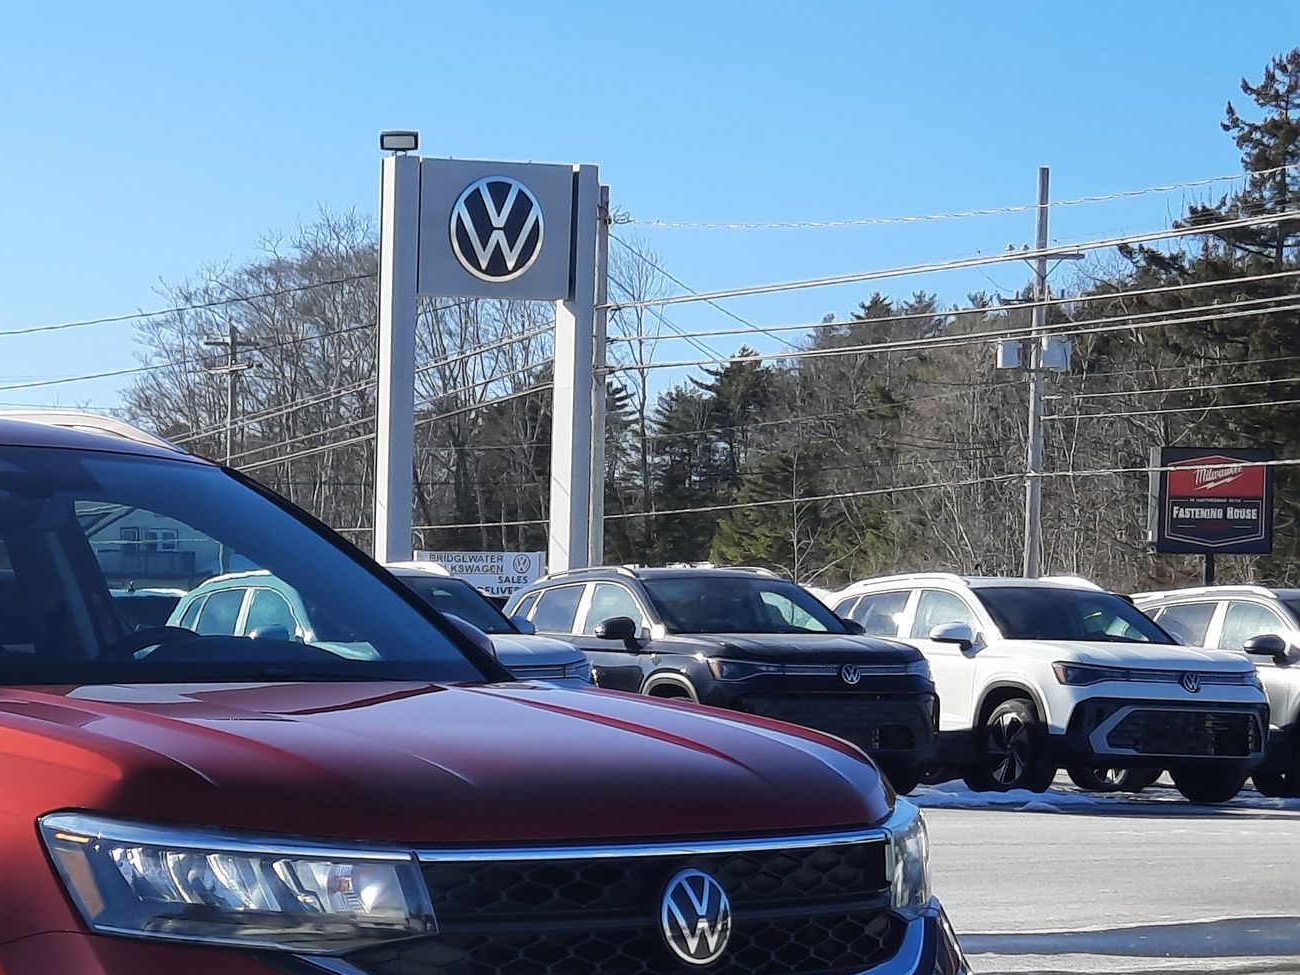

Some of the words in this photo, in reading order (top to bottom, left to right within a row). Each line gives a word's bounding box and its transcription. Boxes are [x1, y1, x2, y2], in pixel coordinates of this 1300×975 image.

[452, 176, 543, 280] VW
[1172, 506, 1224, 519] FASTENING
[1226, 506, 1258, 520] HOUSE
[429, 554, 504, 563] BRIDGEWATER
[498, 575, 528, 584] SALES
[662, 869, 731, 964] VW
